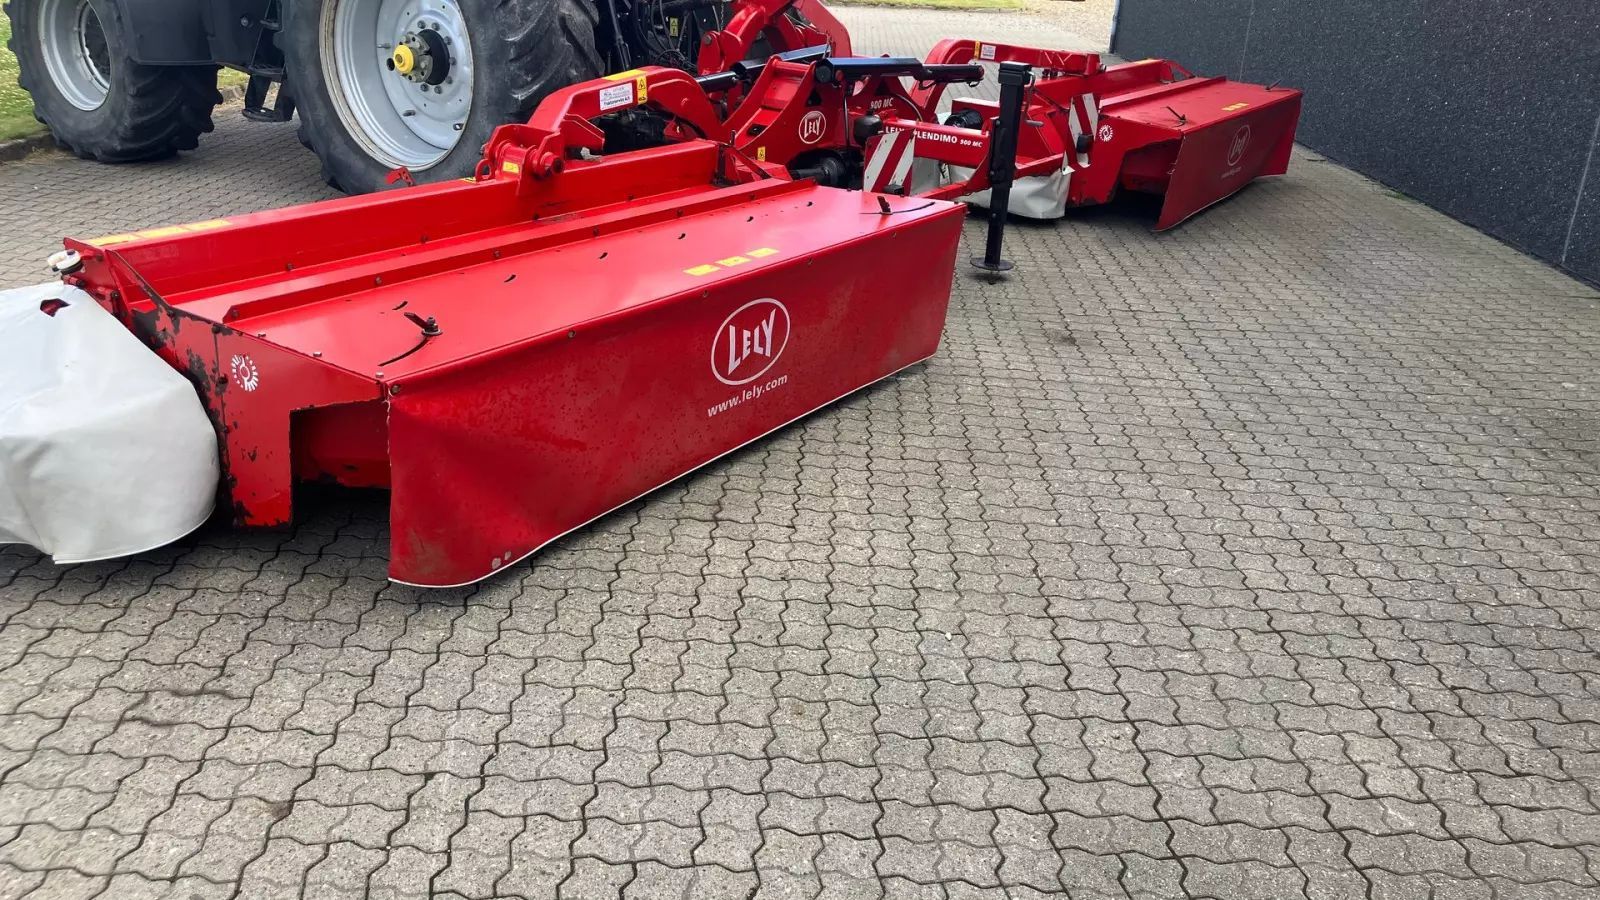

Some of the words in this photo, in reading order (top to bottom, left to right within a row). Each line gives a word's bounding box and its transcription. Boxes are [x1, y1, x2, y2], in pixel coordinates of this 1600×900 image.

[870, 100, 882, 109] 900
[883, 97, 894, 107] MC
[803, 114, 822, 139] LELY
[912, 128, 958, 144] LENDIMO
[960, 138, 971, 146] 900
[972, 140, 983, 148] MC
[728, 308, 776, 375] LELY
[707, 374, 788, 417] www.lely.com
